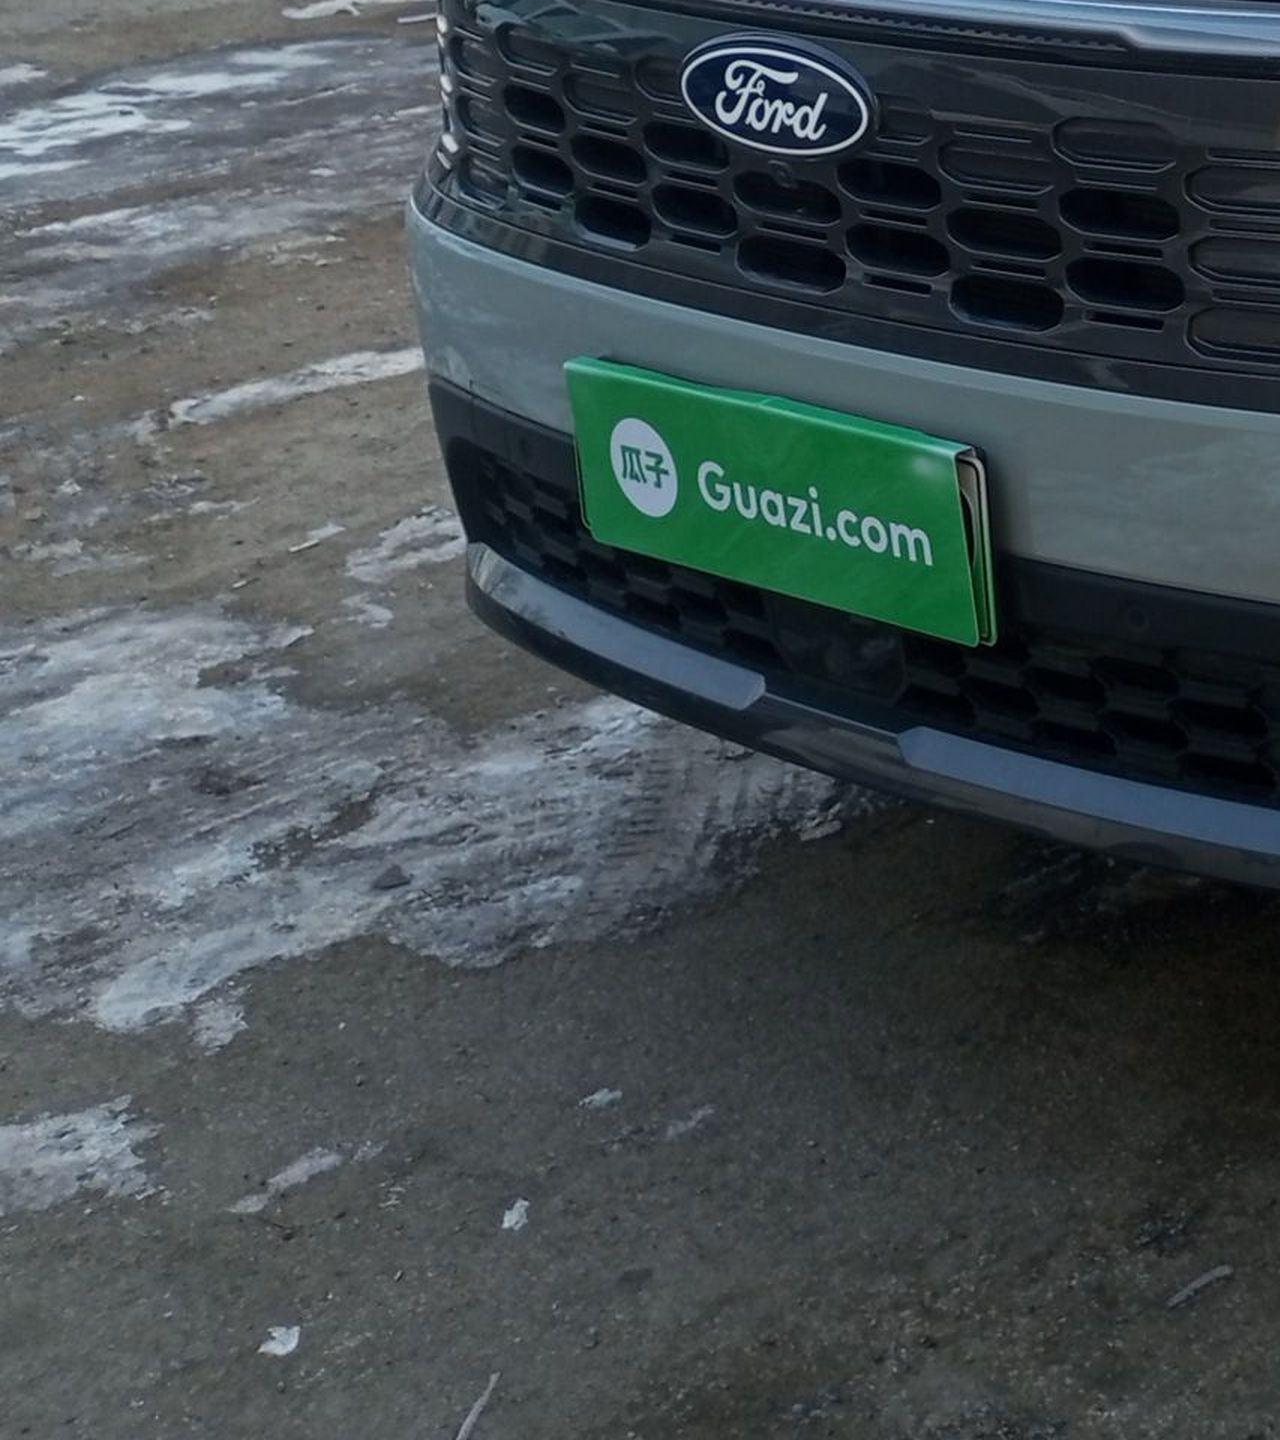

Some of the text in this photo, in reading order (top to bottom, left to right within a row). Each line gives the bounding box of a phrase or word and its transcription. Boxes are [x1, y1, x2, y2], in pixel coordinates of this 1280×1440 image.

[715, 60, 828, 141] Ford
[620, 444, 669, 489] 瓜子
[697, 460, 934, 567] Guazi.com
